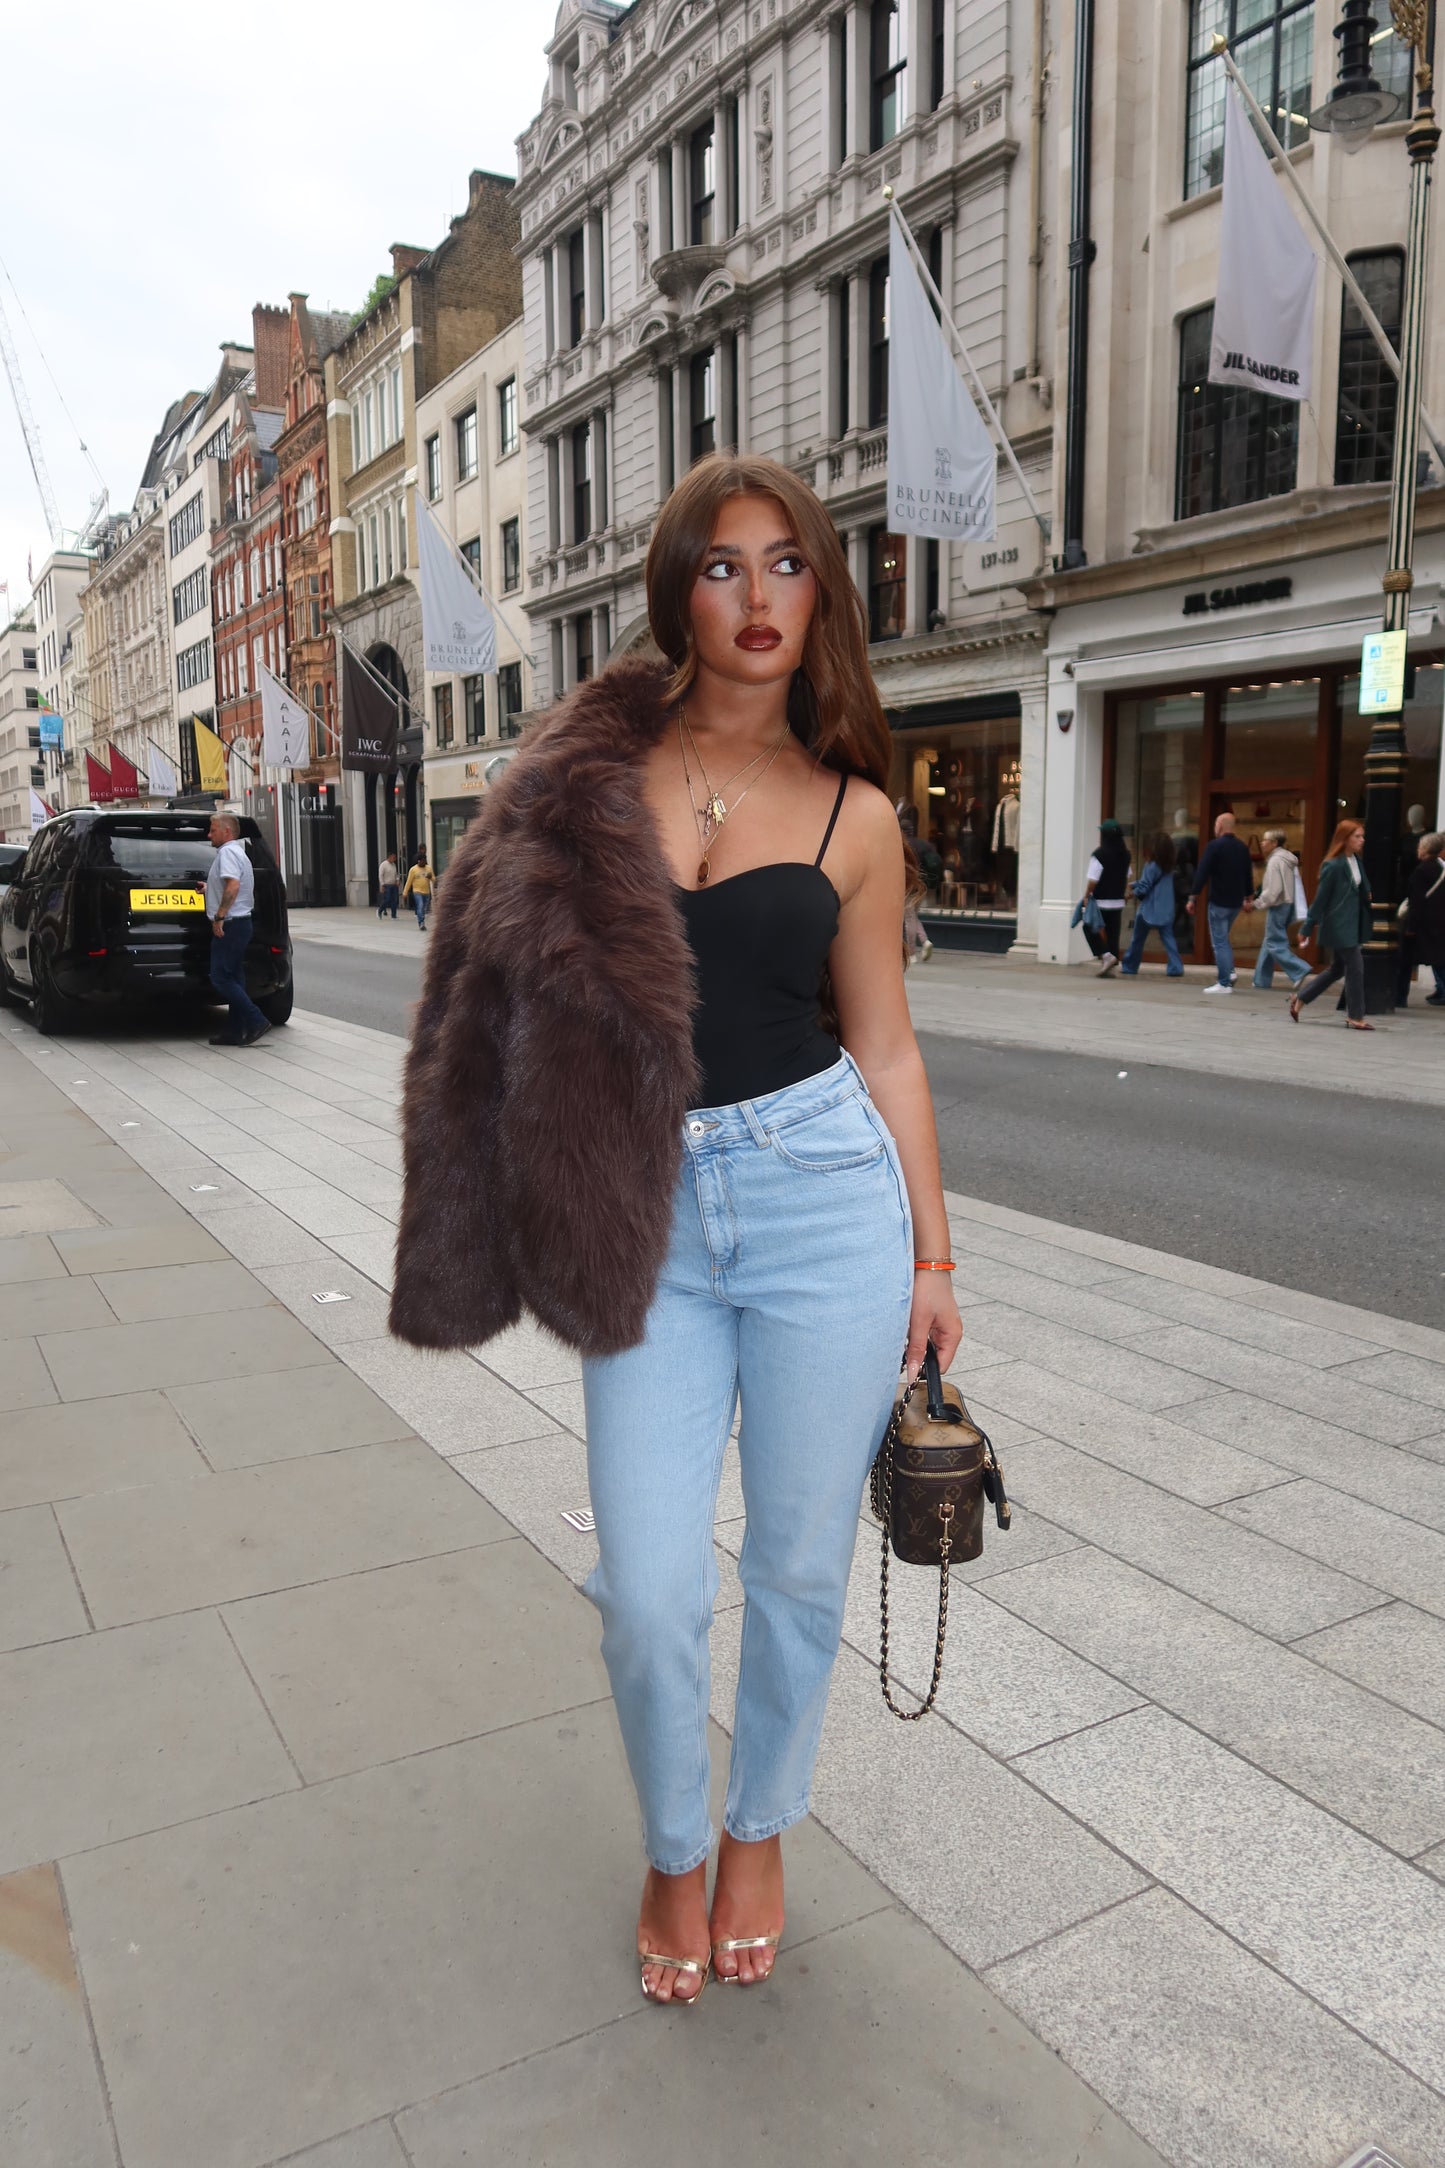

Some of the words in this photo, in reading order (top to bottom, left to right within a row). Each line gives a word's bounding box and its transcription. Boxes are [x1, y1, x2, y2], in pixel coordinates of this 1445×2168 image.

[1223, 352, 1246, 370] JIL
[1246, 356, 1300, 385] SANDER
[896, 485, 987, 509] BRUNELLO
[895, 503, 987, 527] CUCINELLI
[430, 643, 492, 656] BRUNELLO
[358, 737, 382, 752] IWC
[171, 894, 197, 906] SLA
